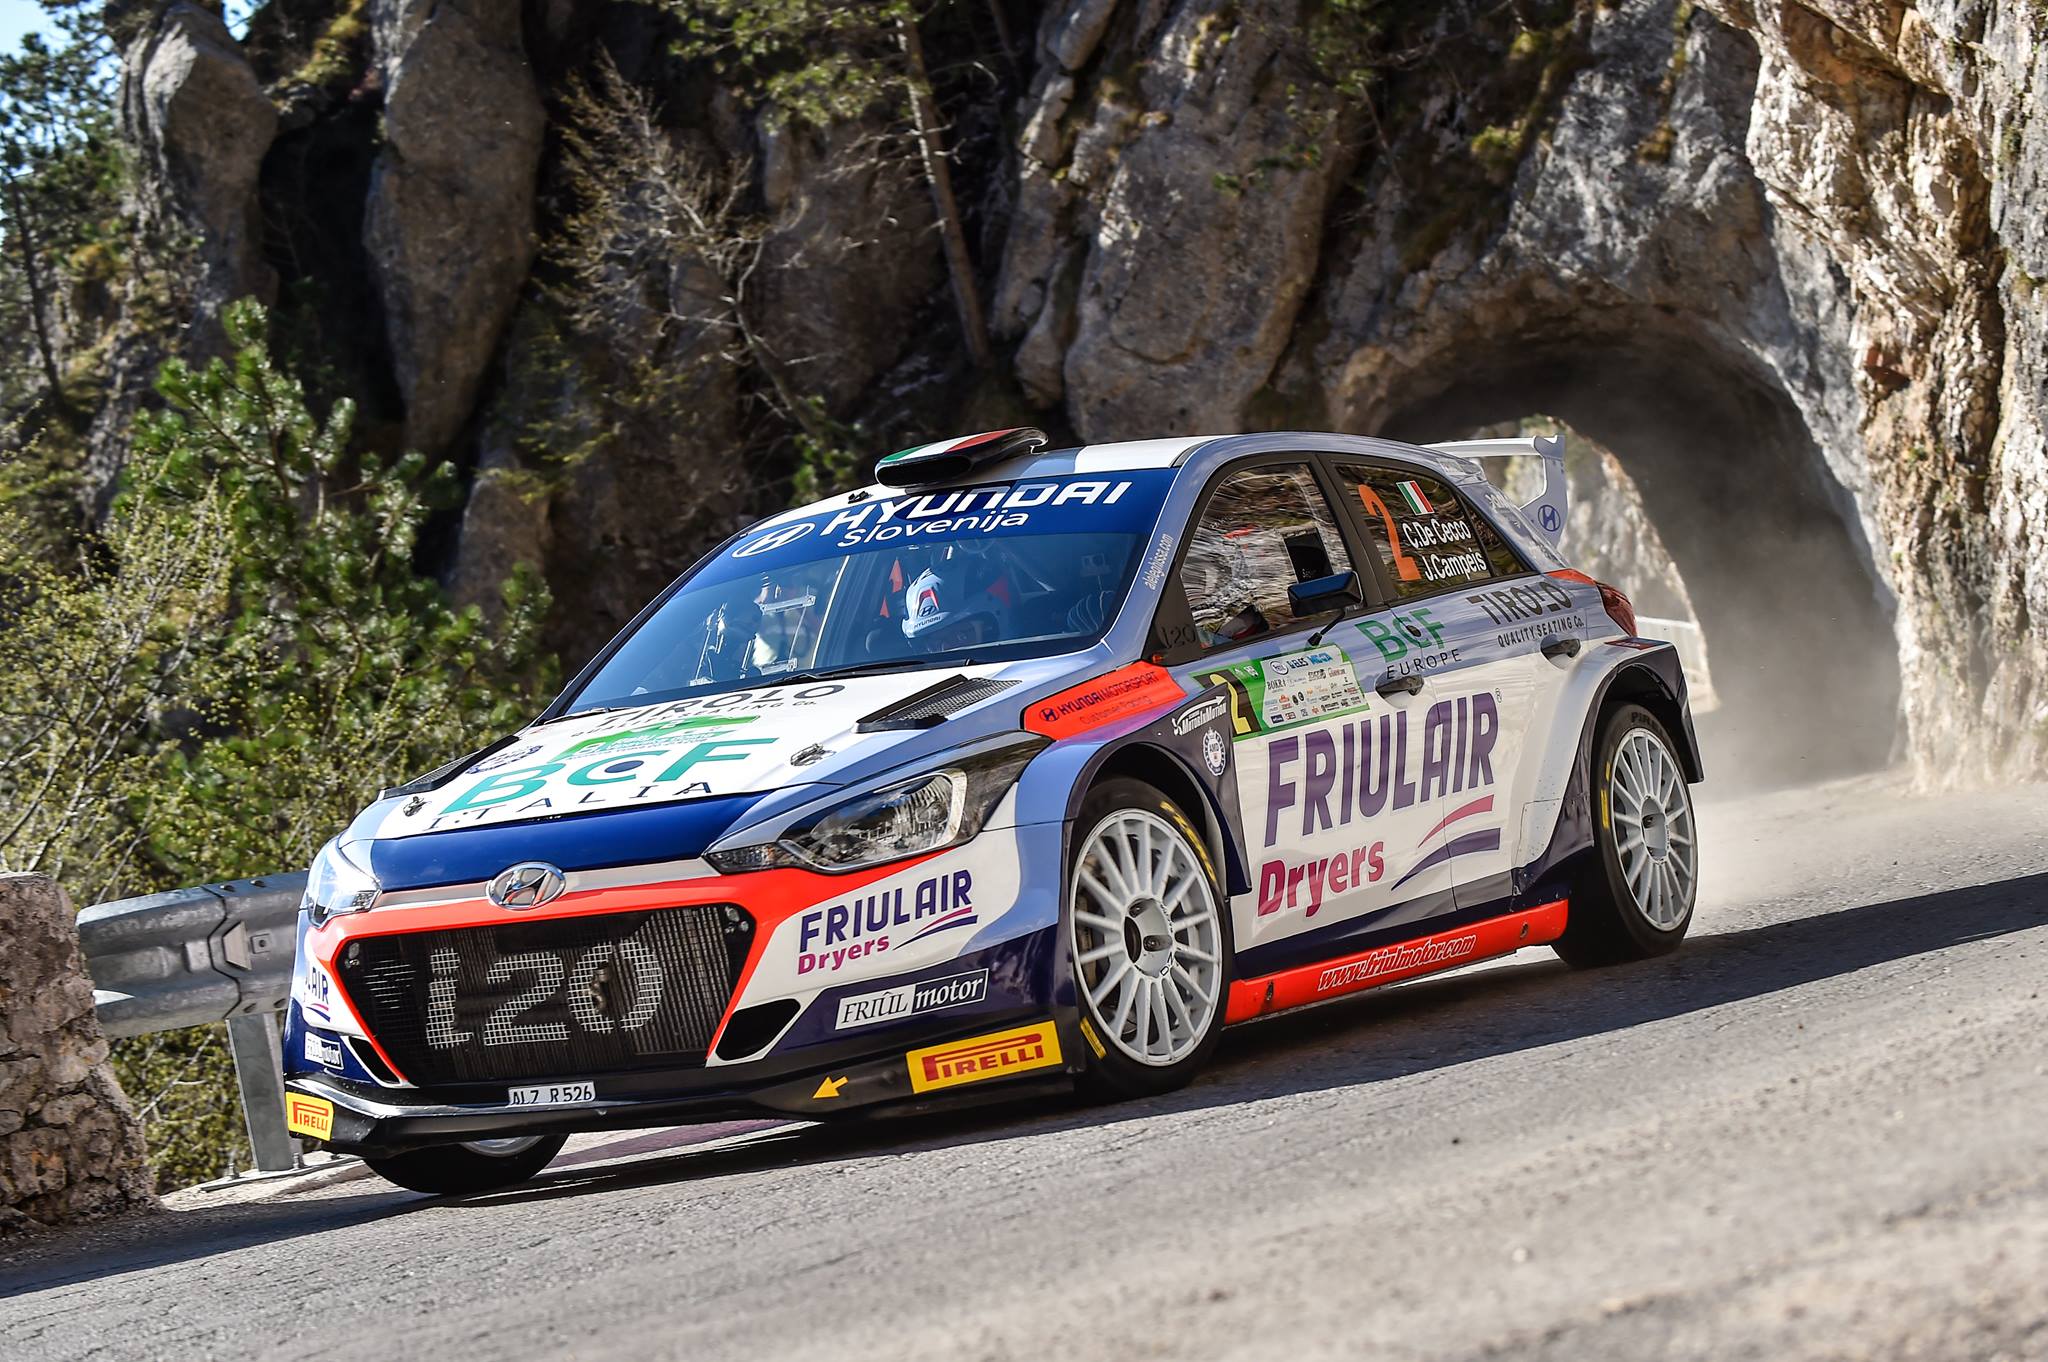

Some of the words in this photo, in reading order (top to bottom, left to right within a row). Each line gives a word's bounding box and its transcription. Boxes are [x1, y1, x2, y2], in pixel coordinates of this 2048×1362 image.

[820, 481, 1133, 537] HYUNDAI
[836, 511, 1030, 549] Slovenija
[1358, 484, 1422, 581] 2
[1466, 581, 1572, 625] TIROLO
[1354, 607, 1447, 663] BCF
[1497, 625, 1536, 648] QUALITY
[1536, 617, 1573, 643] SEATING
[1573, 615, 1585, 628] Co.
[1386, 648, 1462, 681] EUROPE
[597, 684, 846, 728] TIROLO
[1209, 673, 1252, 735] 2
[440, 737, 780, 815] BCF
[1264, 692, 1499, 848] FRIULAIR
[424, 781, 714, 830] ITALIA
[1257, 841, 1385, 918] Dryers
[799, 869, 973, 953] FRIULAIR
[798, 936, 890, 976] Dryers
[1317, 933, 1477, 992] www.friulmotor.com
[914, 976, 983, 1010] motor
[922, 1033, 1045, 1082] PIRELLI
[292, 1101, 329, 1132] PIRELLI
